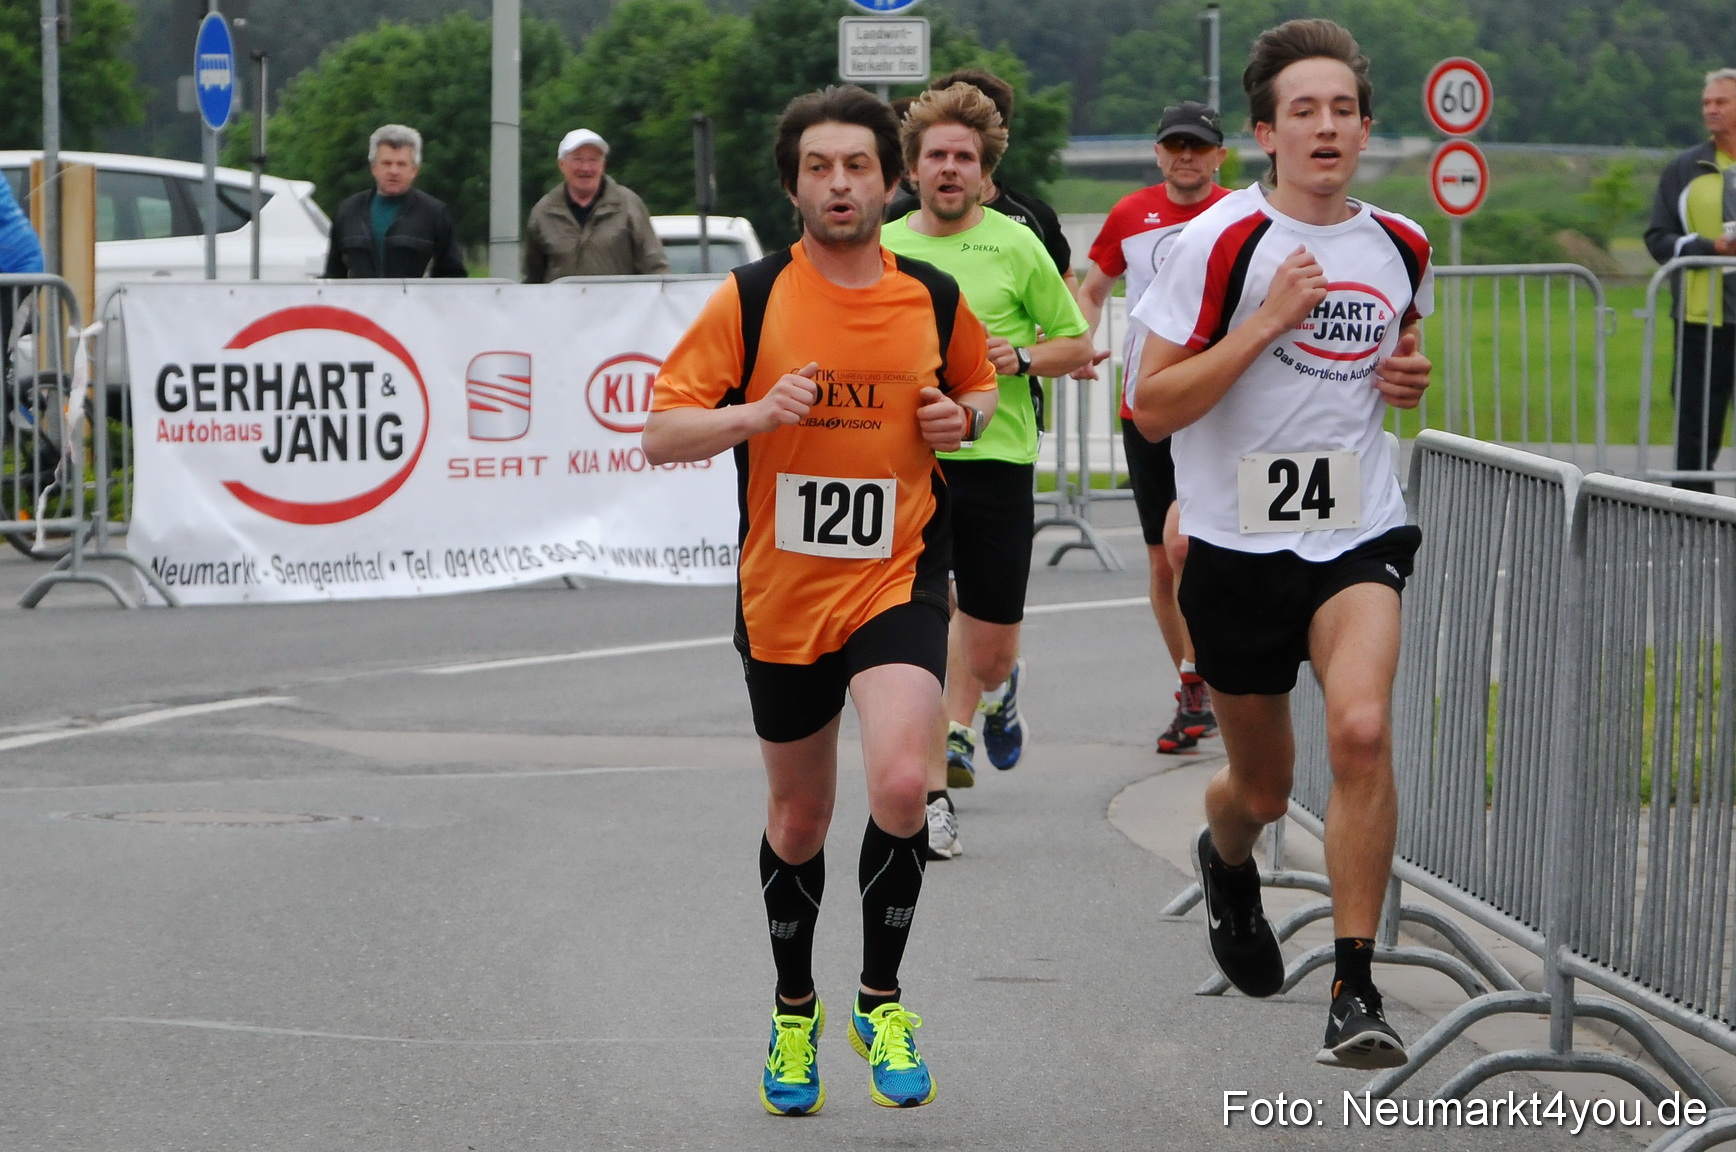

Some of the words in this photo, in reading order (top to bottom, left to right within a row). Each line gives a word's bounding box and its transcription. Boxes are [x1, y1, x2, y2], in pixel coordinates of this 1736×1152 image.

[1441, 80, 1476, 113] 60
[973, 244, 1000, 253] DEKRA
[1313, 321, 1385, 343] JÄNIG
[837, 373, 863, 381] UHREN
[882, 374, 918, 382] SCHMUCK
[1273, 347, 1293, 366] Das
[1295, 361, 1349, 382] sportliche
[156, 361, 374, 413] GERHART
[381, 372, 397, 397] &
[156, 418, 263, 443] Autohaus
[261, 411, 404, 463] JÄNIG
[447, 455, 548, 479] SEAT
[568, 450, 600, 474] KIA
[1267, 458, 1336, 521] 24
[798, 481, 884, 547] 120
[149, 553, 261, 586] Neumarkt
[271, 553, 384, 592] Sengenthal
[402, 549, 440, 579] Tel.
